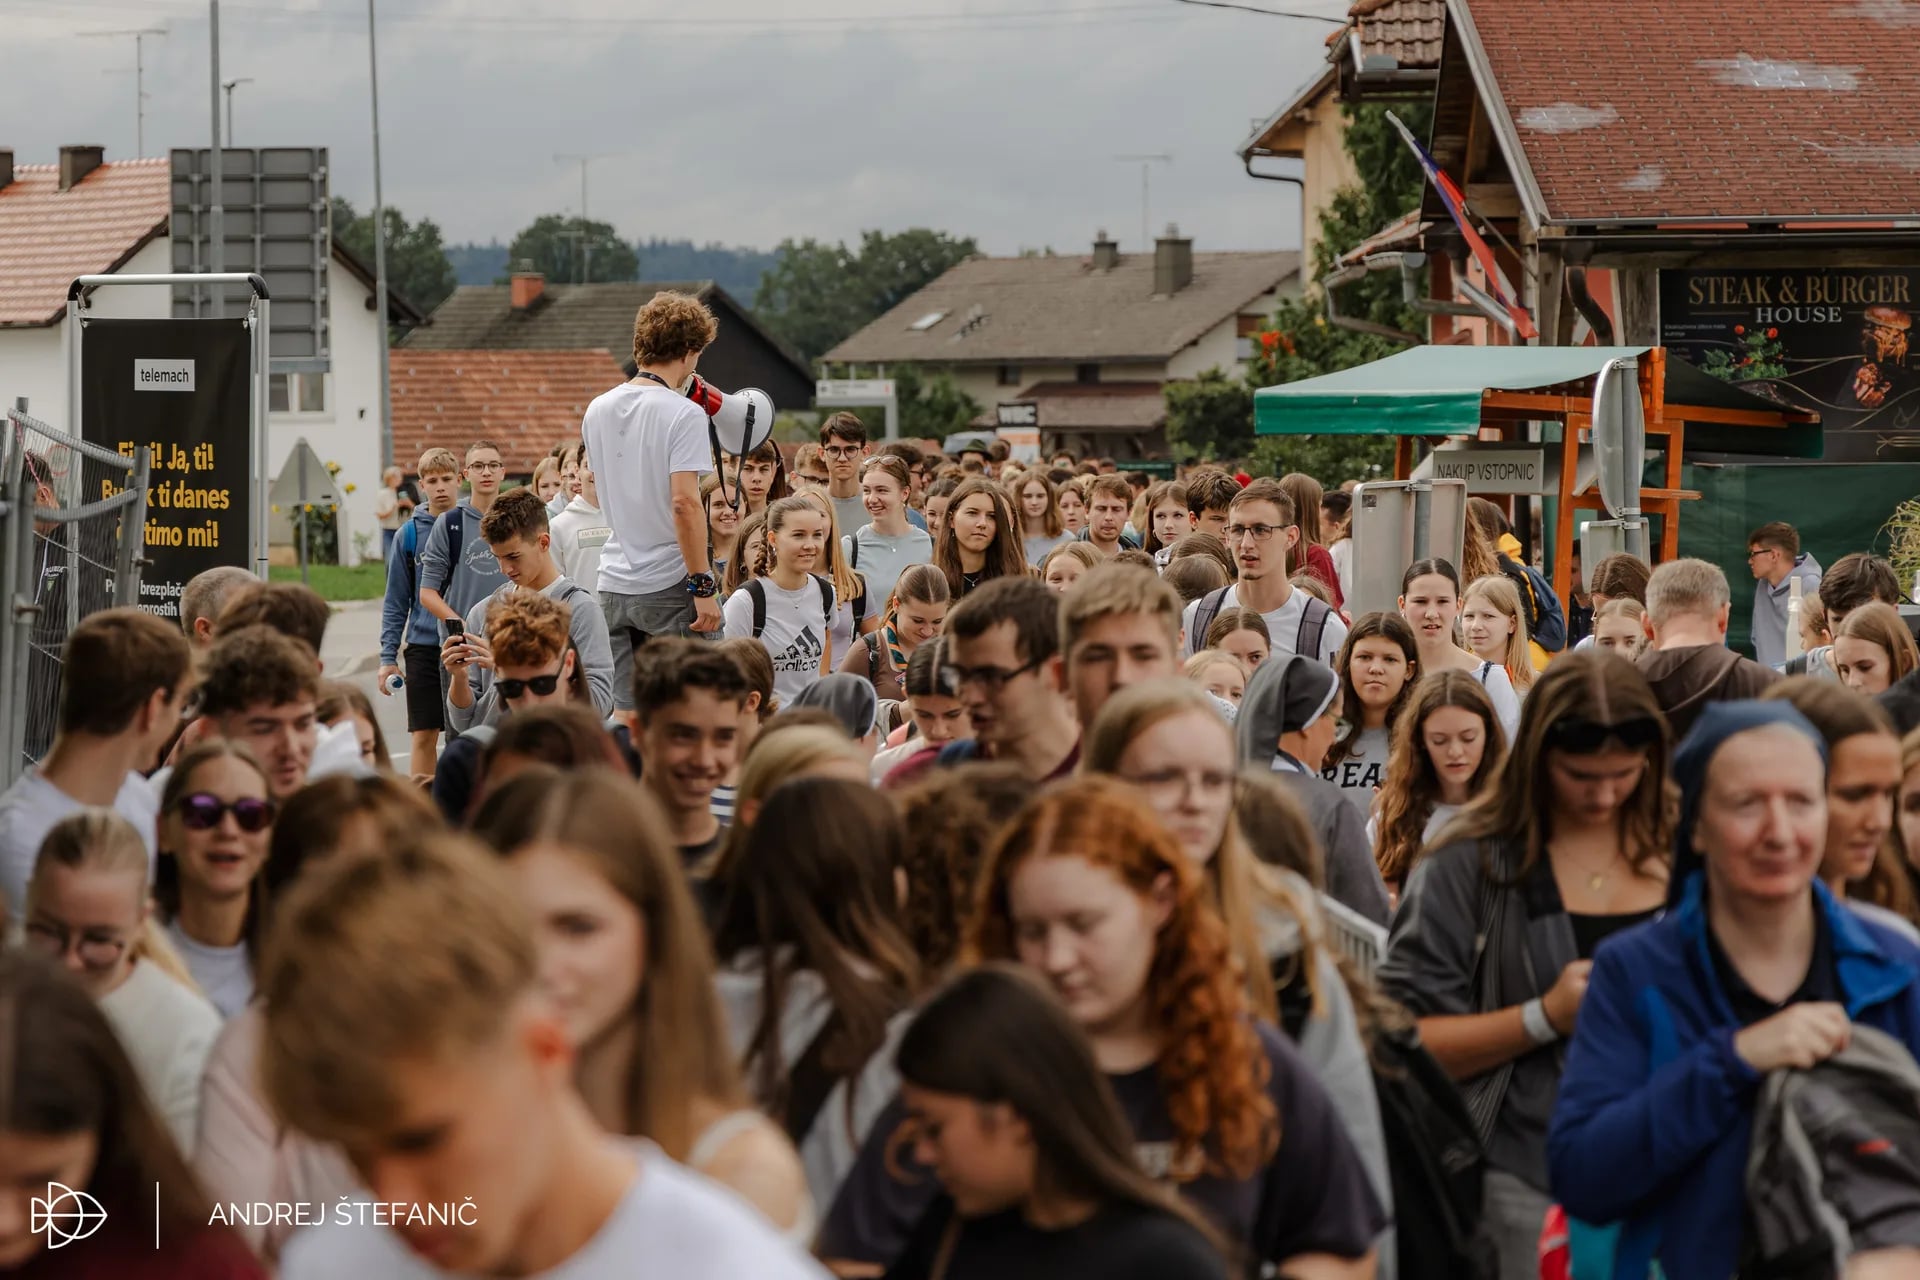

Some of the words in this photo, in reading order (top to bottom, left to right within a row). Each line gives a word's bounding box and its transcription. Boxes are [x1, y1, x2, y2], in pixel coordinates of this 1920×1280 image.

[1689, 276, 1773, 305] STEAK
[1779, 275, 1799, 304] &
[1806, 274, 1911, 304] BURGER
[1756, 306, 1842, 324] HOUSE
[140, 367, 189, 383] telemach
[166, 442, 190, 474] Ja,
[193, 442, 215, 471] ti!
[1437, 463, 1475, 480] NAKUP
[1477, 463, 1535, 481] VSTOPNIC
[157, 480, 170, 508] ti
[173, 480, 230, 509] danes
[187, 519, 219, 548] mi!
